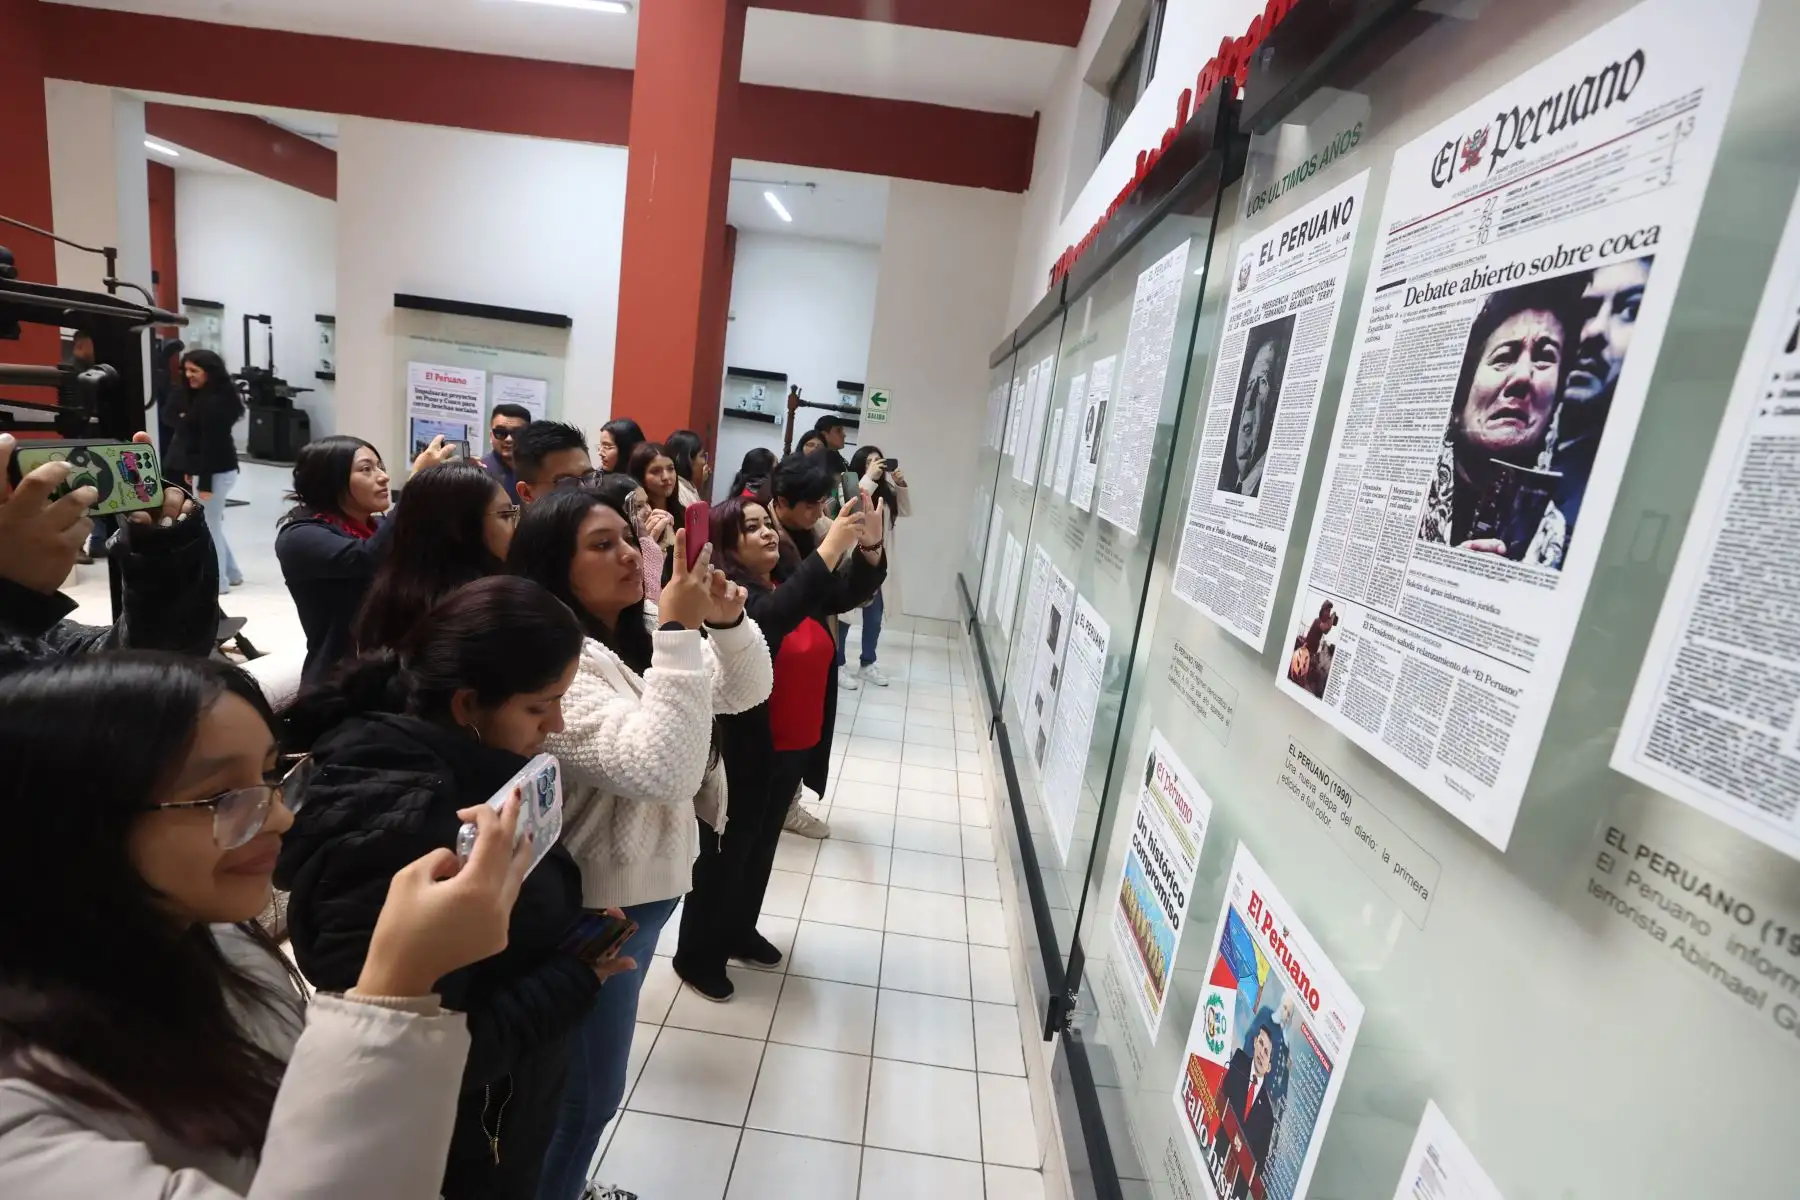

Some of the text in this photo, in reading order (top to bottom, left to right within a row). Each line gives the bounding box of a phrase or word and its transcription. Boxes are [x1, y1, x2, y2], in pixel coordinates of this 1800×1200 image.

[1431, 134, 1463, 190] El
[1486, 47, 1647, 178] Peruano
[1246, 190, 1267, 219] LOS
[1318, 121, 1363, 171] AÑOS
[1258, 239, 1275, 267] EL
[1279, 195, 1354, 257] PERUANO
[1403, 223, 1662, 309] Debate abierto sobre coca
[1291, 277, 1337, 302] CONSTITUCIONAL
[1315, 287, 1335, 302] TERRY
[425, 372, 467, 385] El Peruano
[867, 412, 886, 422] SALIDA
[1368, 623, 1398, 643] Presidente
[1396, 637, 1416, 652] saluda
[1415, 645, 1462, 672] relanzamiento
[1461, 664, 1472, 675] de
[1280, 771, 1301, 798] edición
[1305, 793, 1315, 813] full
[1314, 806, 1333, 829] color.
[1288, 742, 1352, 809] EL PERUANO (1990)
[1136, 809, 1148, 839] Un
[1147, 830, 1185, 909] histórico
[1284, 756, 1430, 902] Una nueva etapa del diario: la primera
[1132, 832, 1180, 931] compromiso
[1595, 851, 1617, 875] El
[1624, 868, 1713, 938] Peruano
[1603, 825, 1631, 856] EL
[1633, 842, 1756, 926] PERUANO
[1247, 889, 1263, 925] El
[1261, 909, 1321, 1012] Peruano
[1586, 876, 1669, 944] terrorista
[1668, 934, 1769, 1013] Abimael
[1182, 1070, 1209, 1149] Fallo
